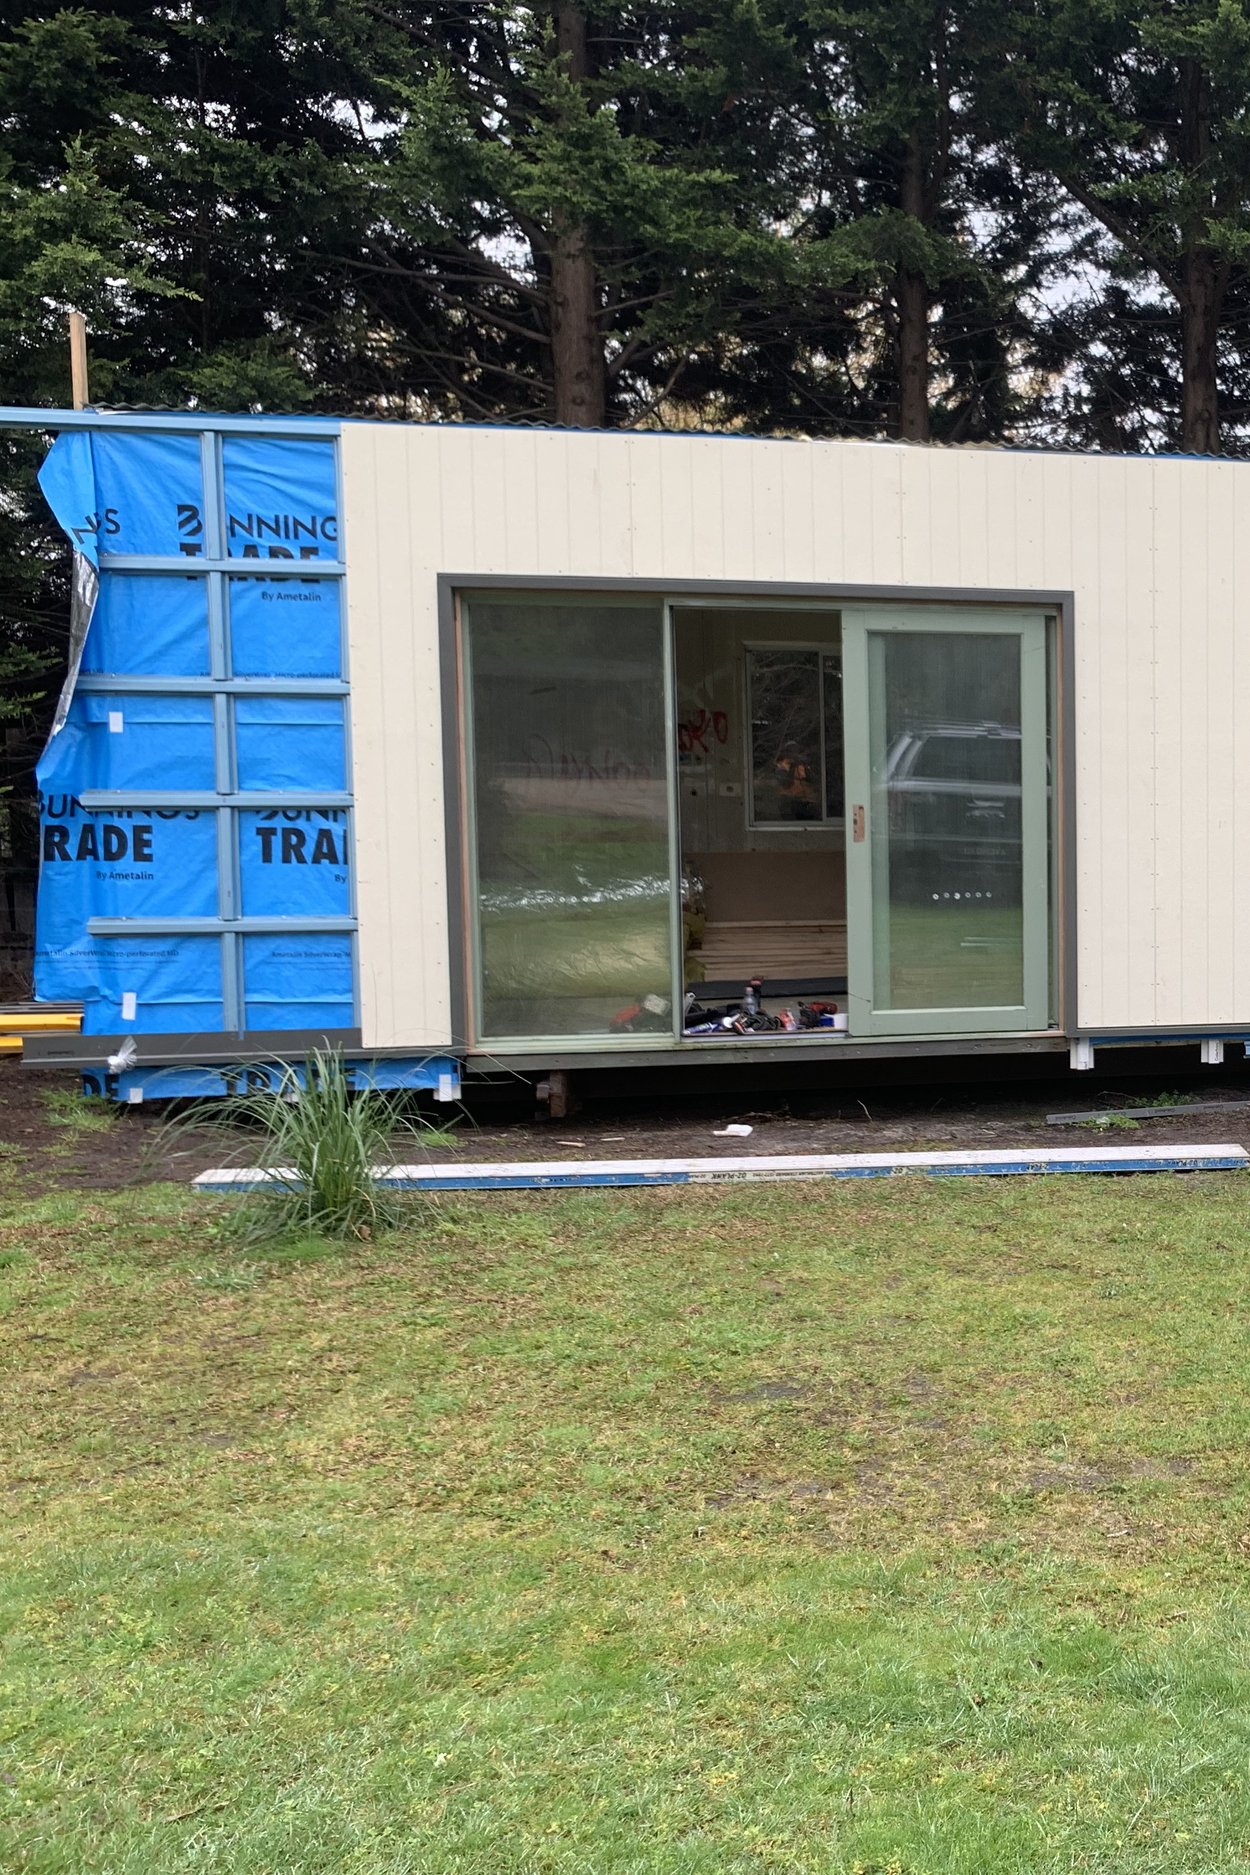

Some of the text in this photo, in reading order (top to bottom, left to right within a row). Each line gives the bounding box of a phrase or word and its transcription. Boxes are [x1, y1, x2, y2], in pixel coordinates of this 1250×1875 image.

[262, 591, 322, 603] By Ametalin
[256, 827, 348, 865] TRA
[108, 871, 154, 880] Ametalin
[335, 874, 347, 885] By
